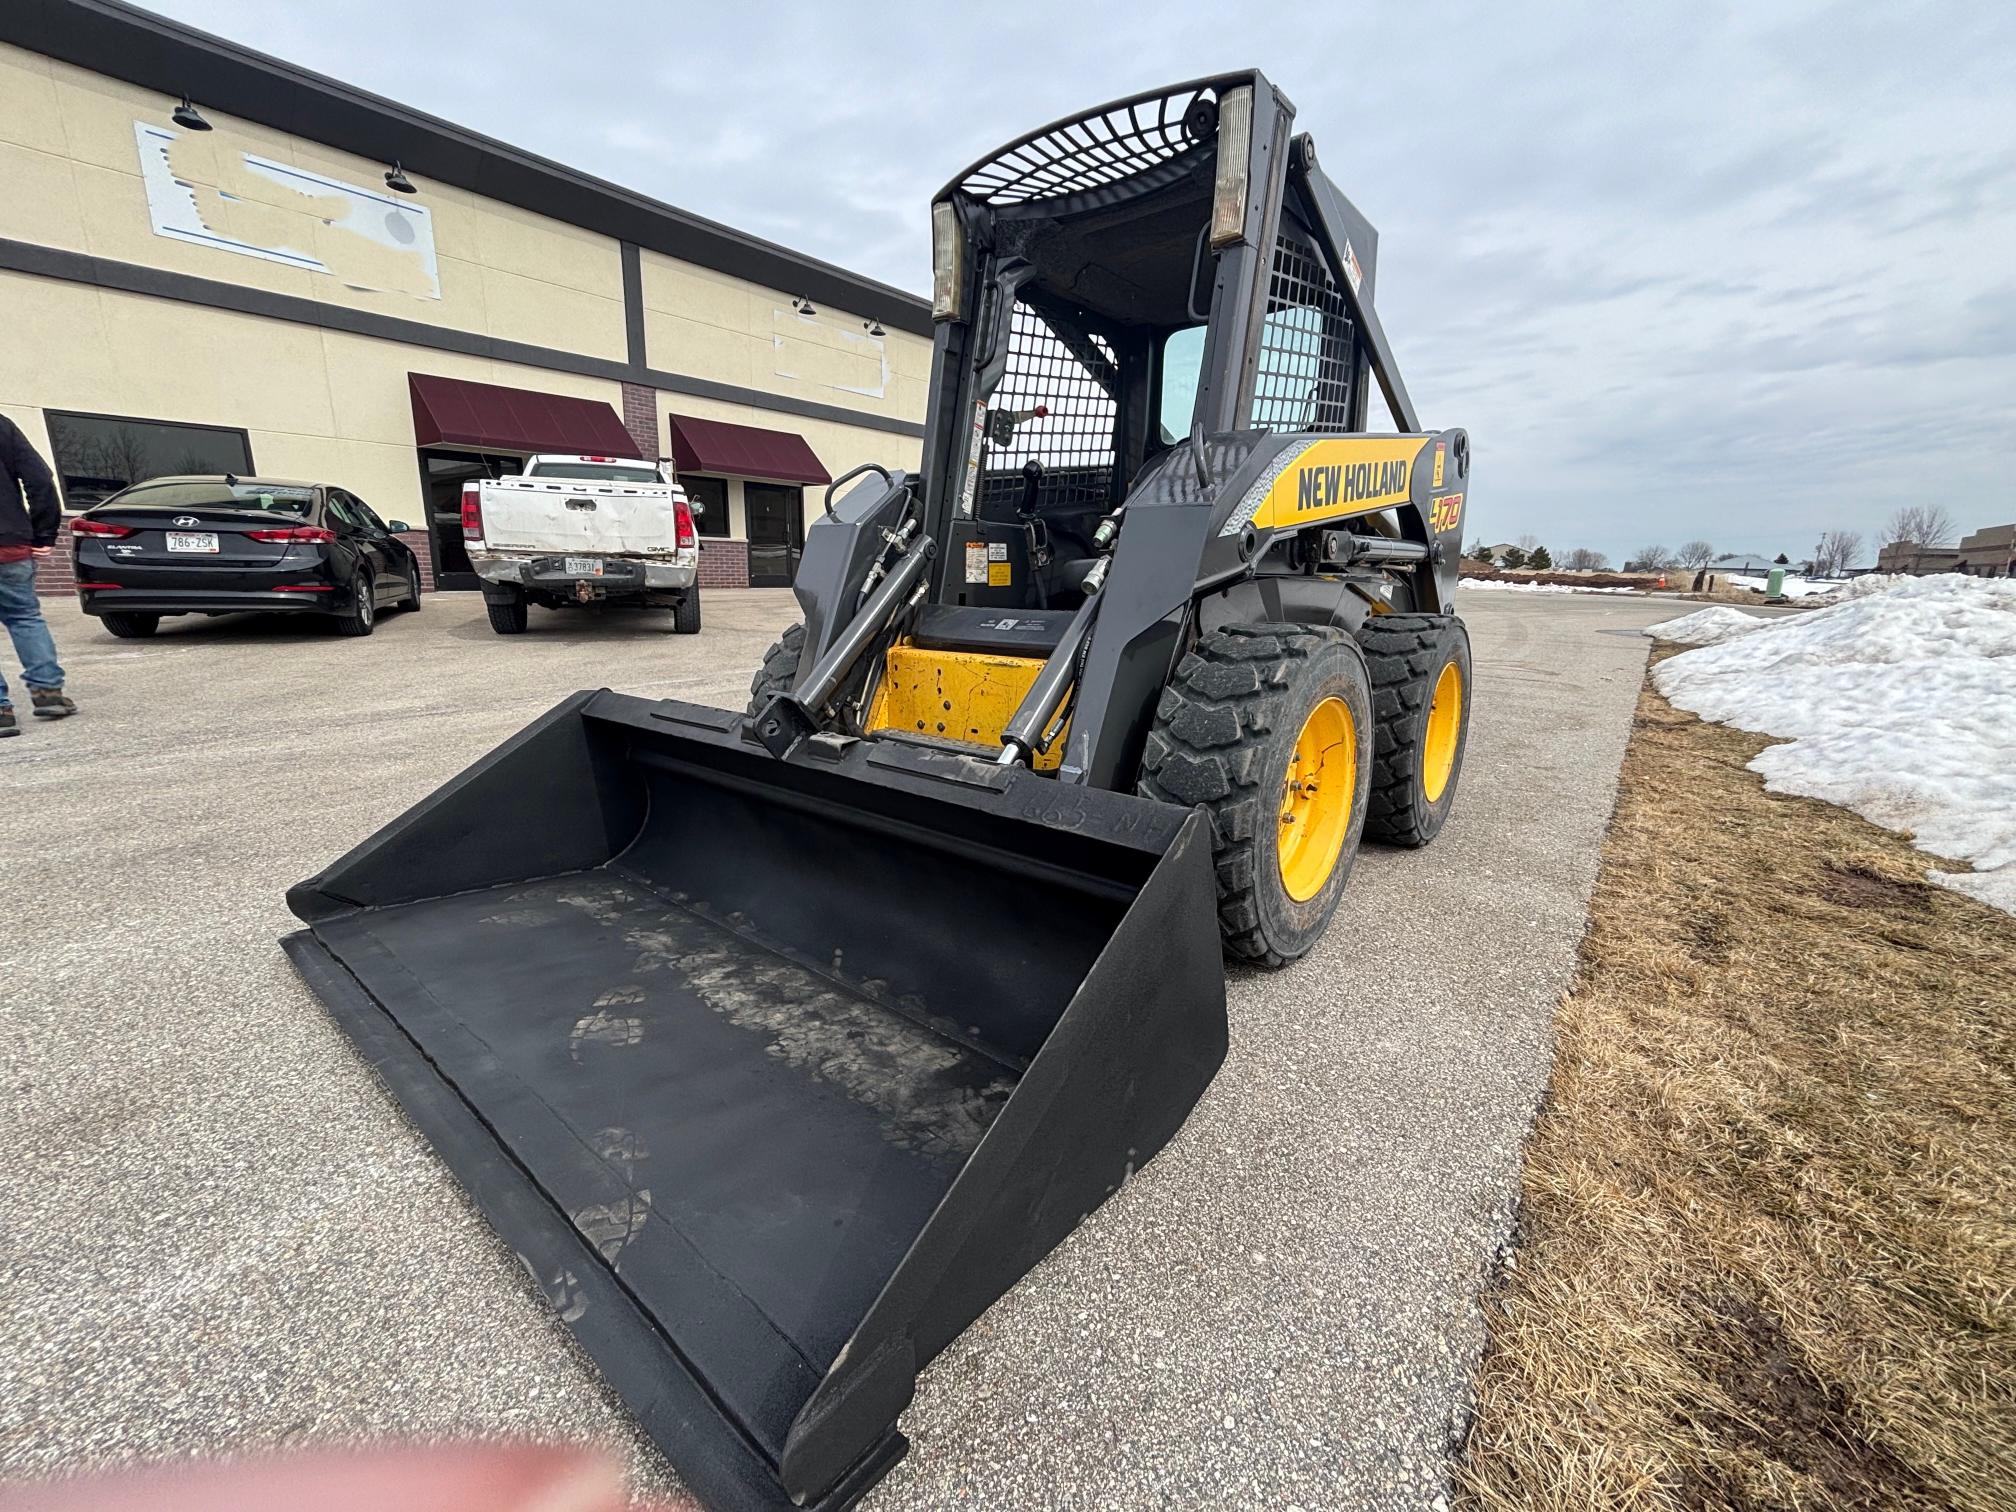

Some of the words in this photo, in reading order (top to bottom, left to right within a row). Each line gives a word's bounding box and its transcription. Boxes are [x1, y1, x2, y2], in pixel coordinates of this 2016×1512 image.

[1298, 465, 1342, 511] NEW
[1343, 460, 1407, 503] HOLLAND
[171, 537, 214, 548] 786-ZSK
